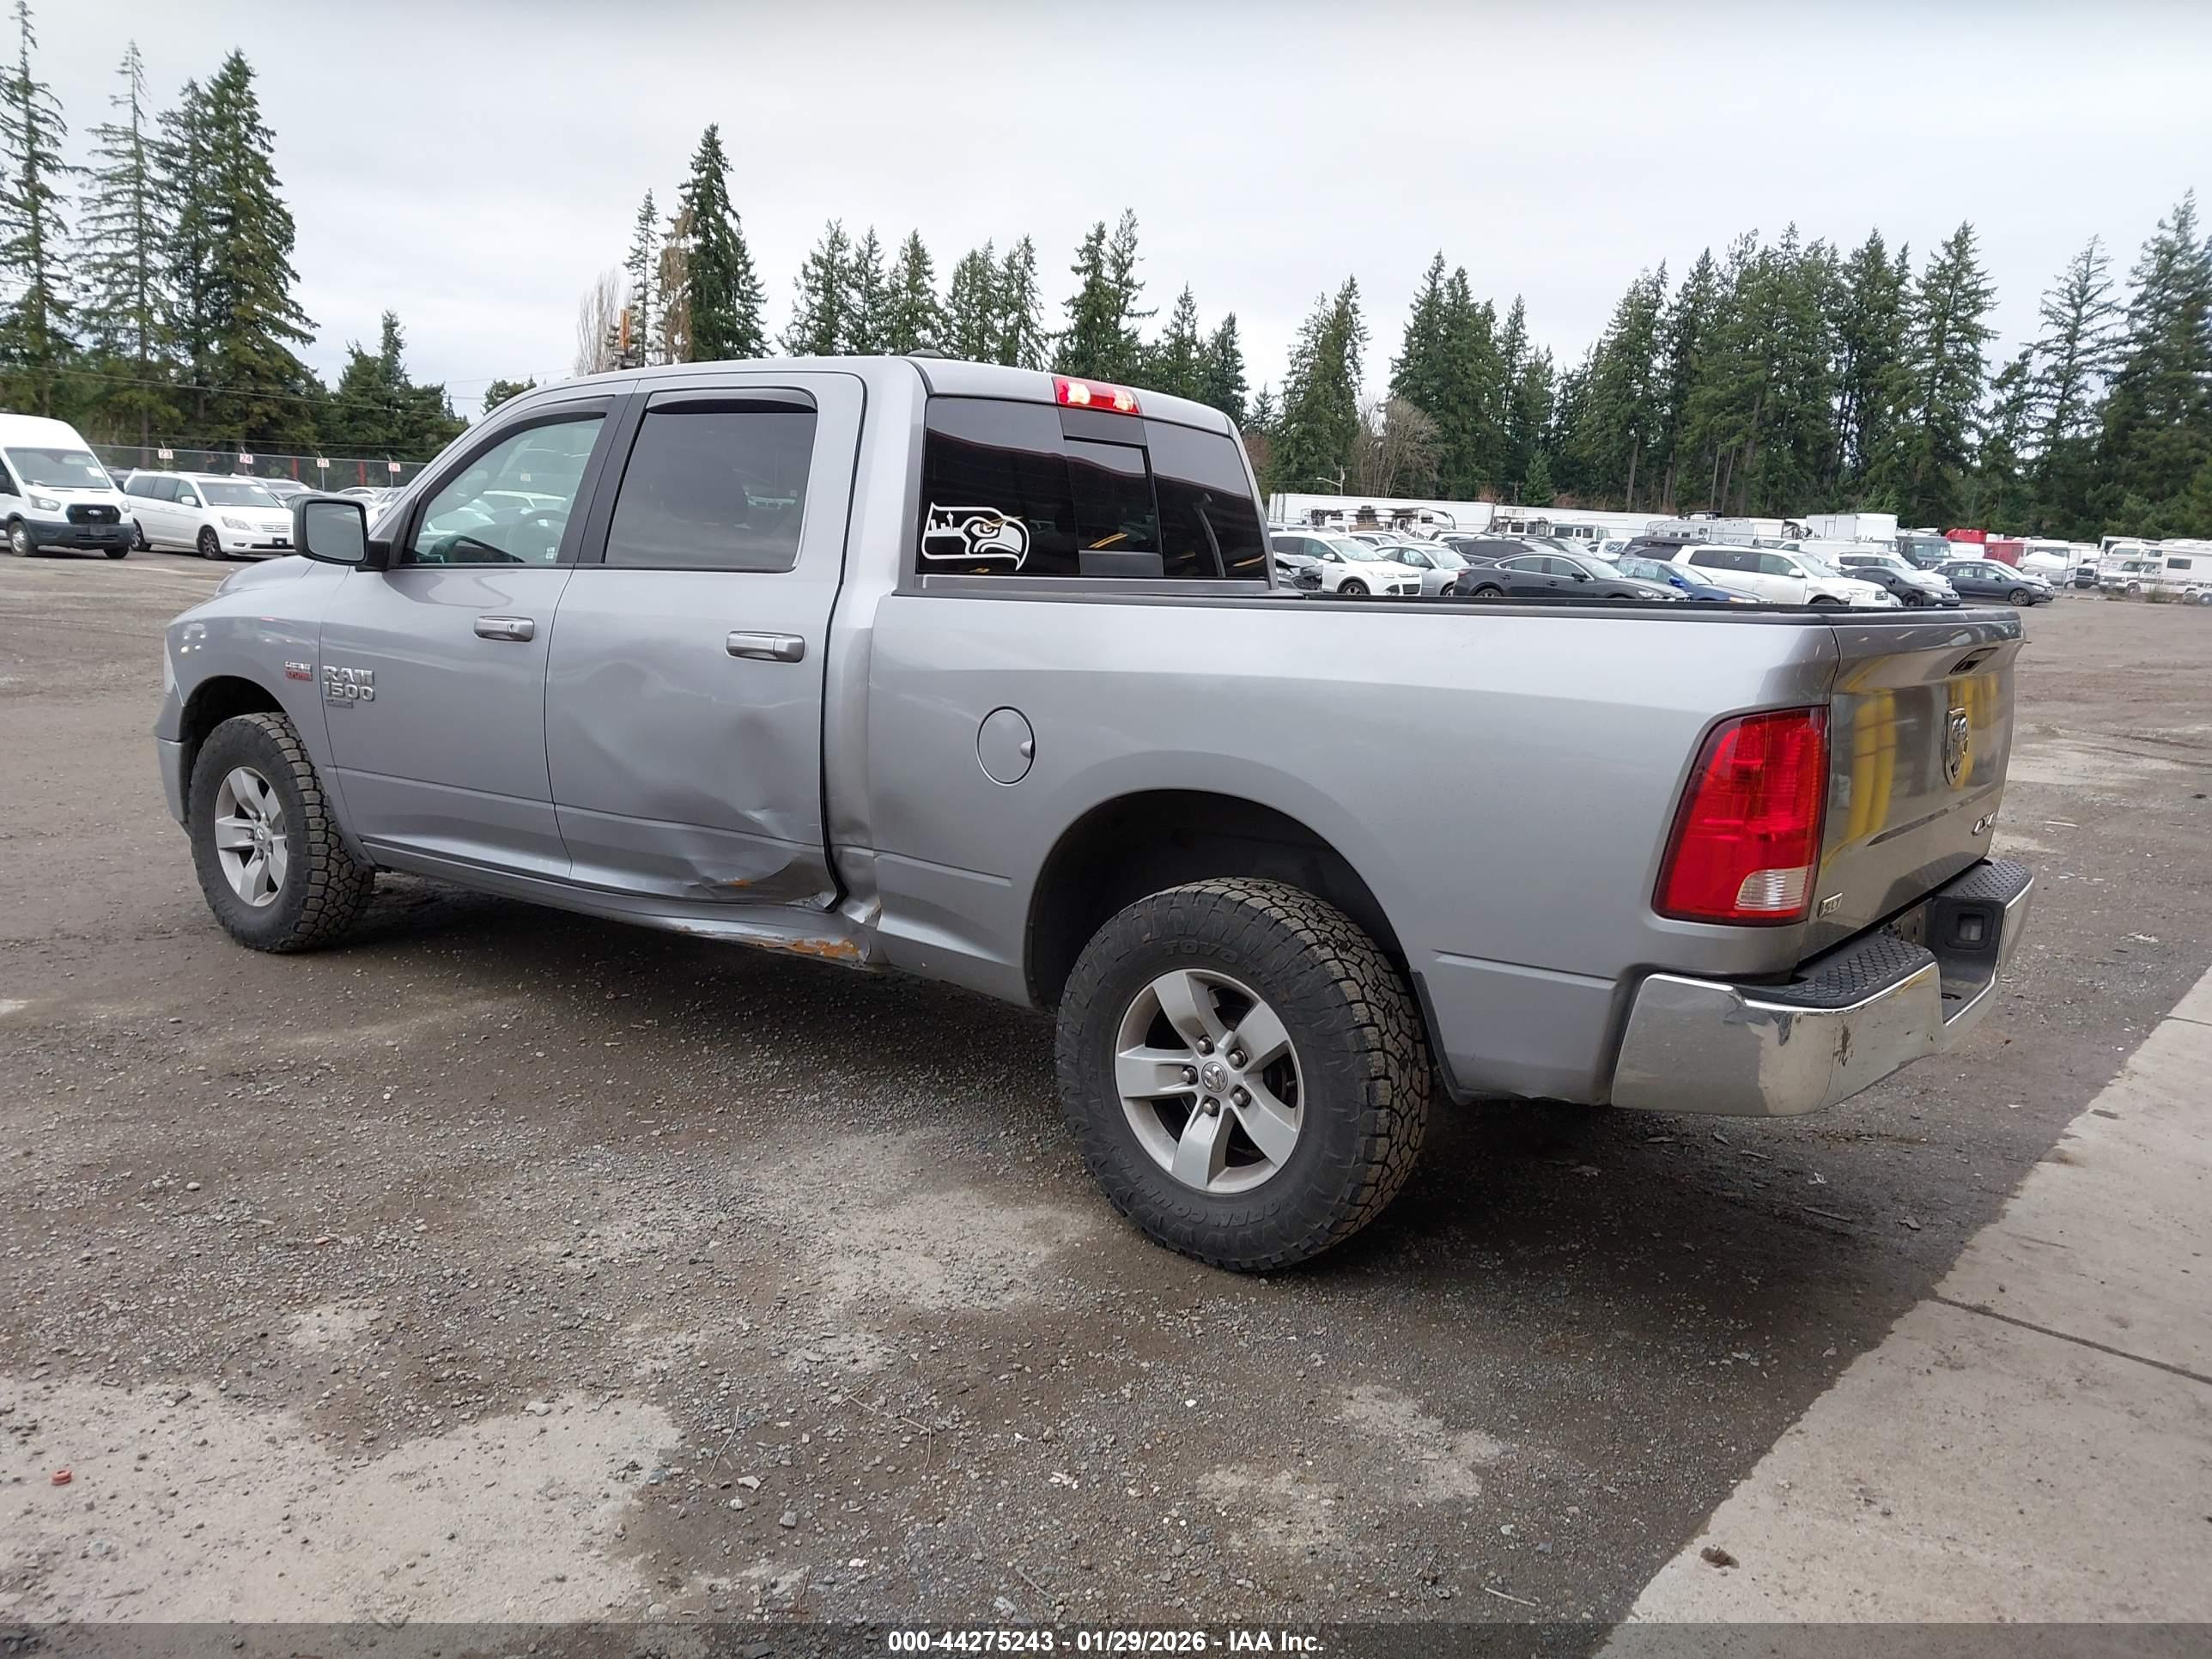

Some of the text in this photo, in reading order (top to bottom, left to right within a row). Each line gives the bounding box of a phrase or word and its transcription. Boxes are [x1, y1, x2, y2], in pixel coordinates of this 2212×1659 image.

[240, 455, 252, 464] 24
[323, 665, 374, 685] RAM
[324, 681, 375, 702] 1500
